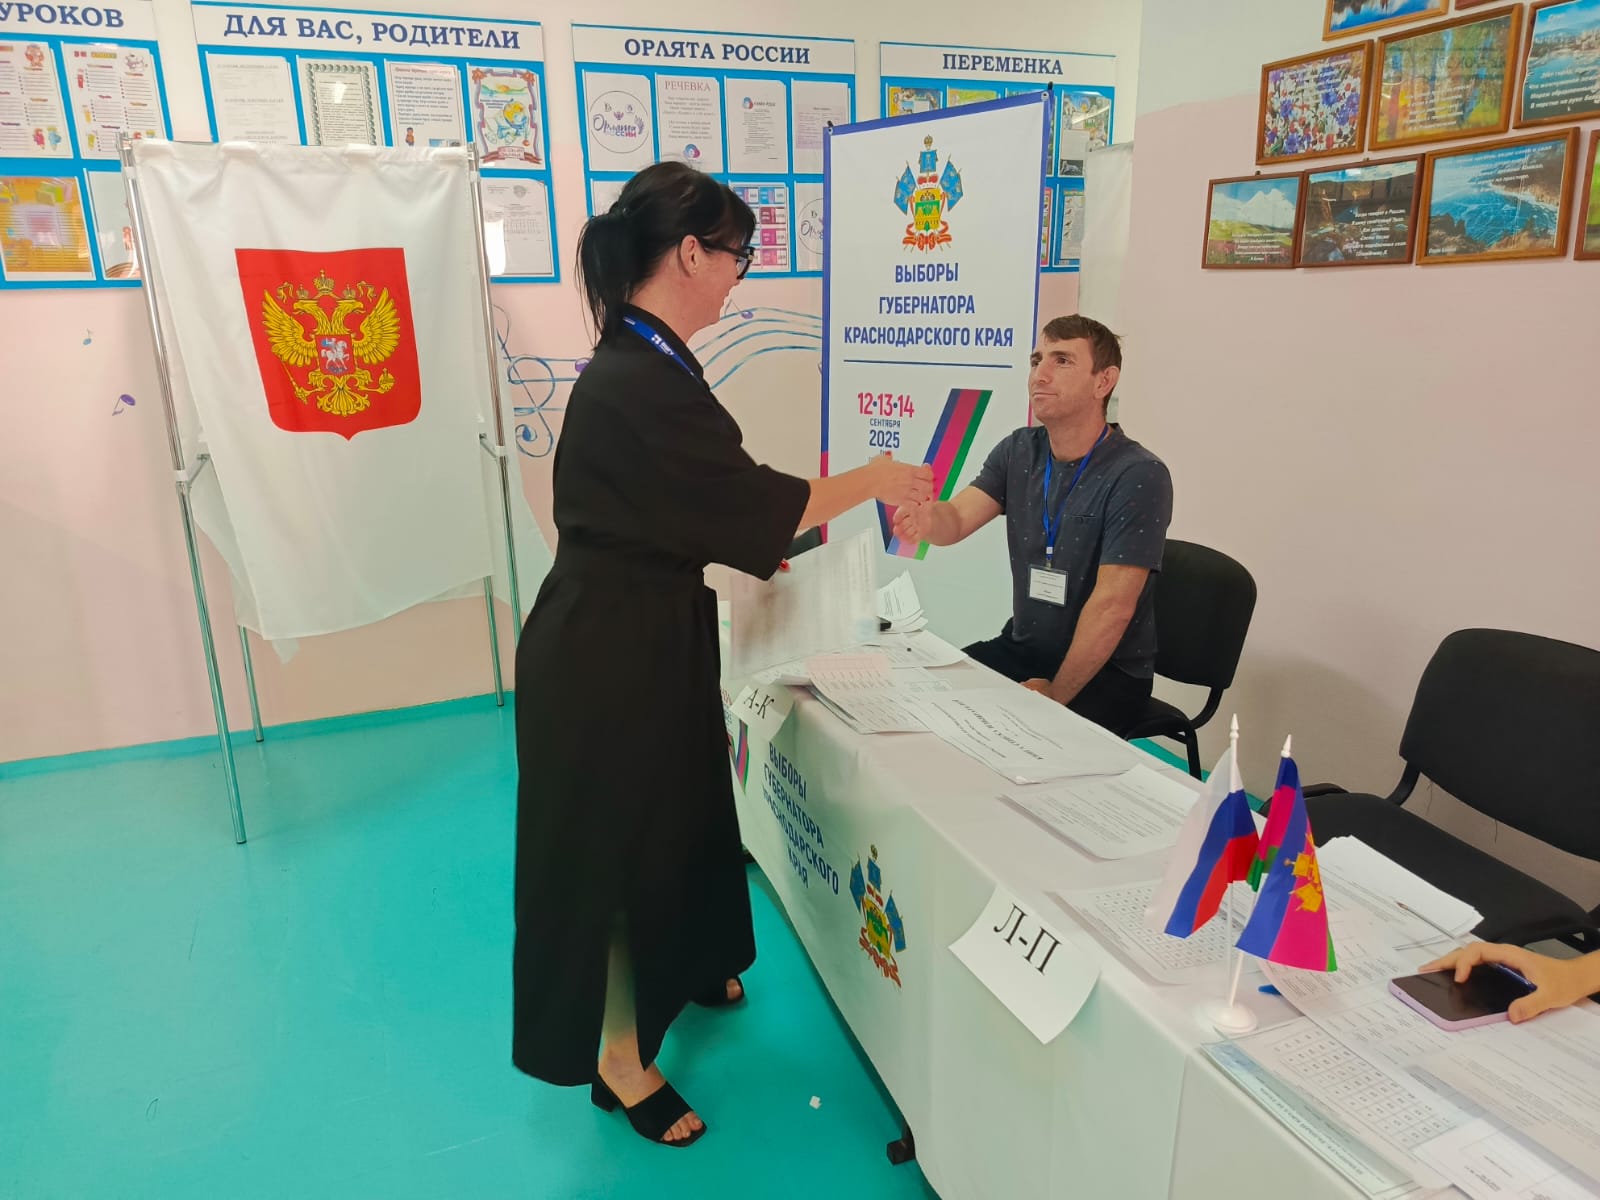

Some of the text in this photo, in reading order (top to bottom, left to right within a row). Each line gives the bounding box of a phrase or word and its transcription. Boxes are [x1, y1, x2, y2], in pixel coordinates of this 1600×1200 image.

[0, 2, 124, 28] УРОКОВ
[224, 14, 520, 49] ДЛЯ ВАС, РОДИТЕЛИ
[624, 38, 810, 64] ОРЛЯТА РОССИИ
[943, 53, 1063, 75] ПЕРЕМЕНКА
[664, 80, 711, 92] РЕЧЕВКА
[895, 262, 959, 283] ВЫБОРЫ
[879, 294, 975, 315] ГУБЕРНАТОРА
[844, 326, 1014, 347] КРАСНОДАРСКОГО КРАЯ
[869, 418, 901, 428] СЕНТЯБРЯ
[869, 429, 900, 449] 2025
[743, 688, 775, 719] А-К
[769, 742, 807, 801] ВЫБОРЫ
[764, 763, 824, 848] ГУБЕРНАТОРА
[993, 903, 1062, 975] Л-П
